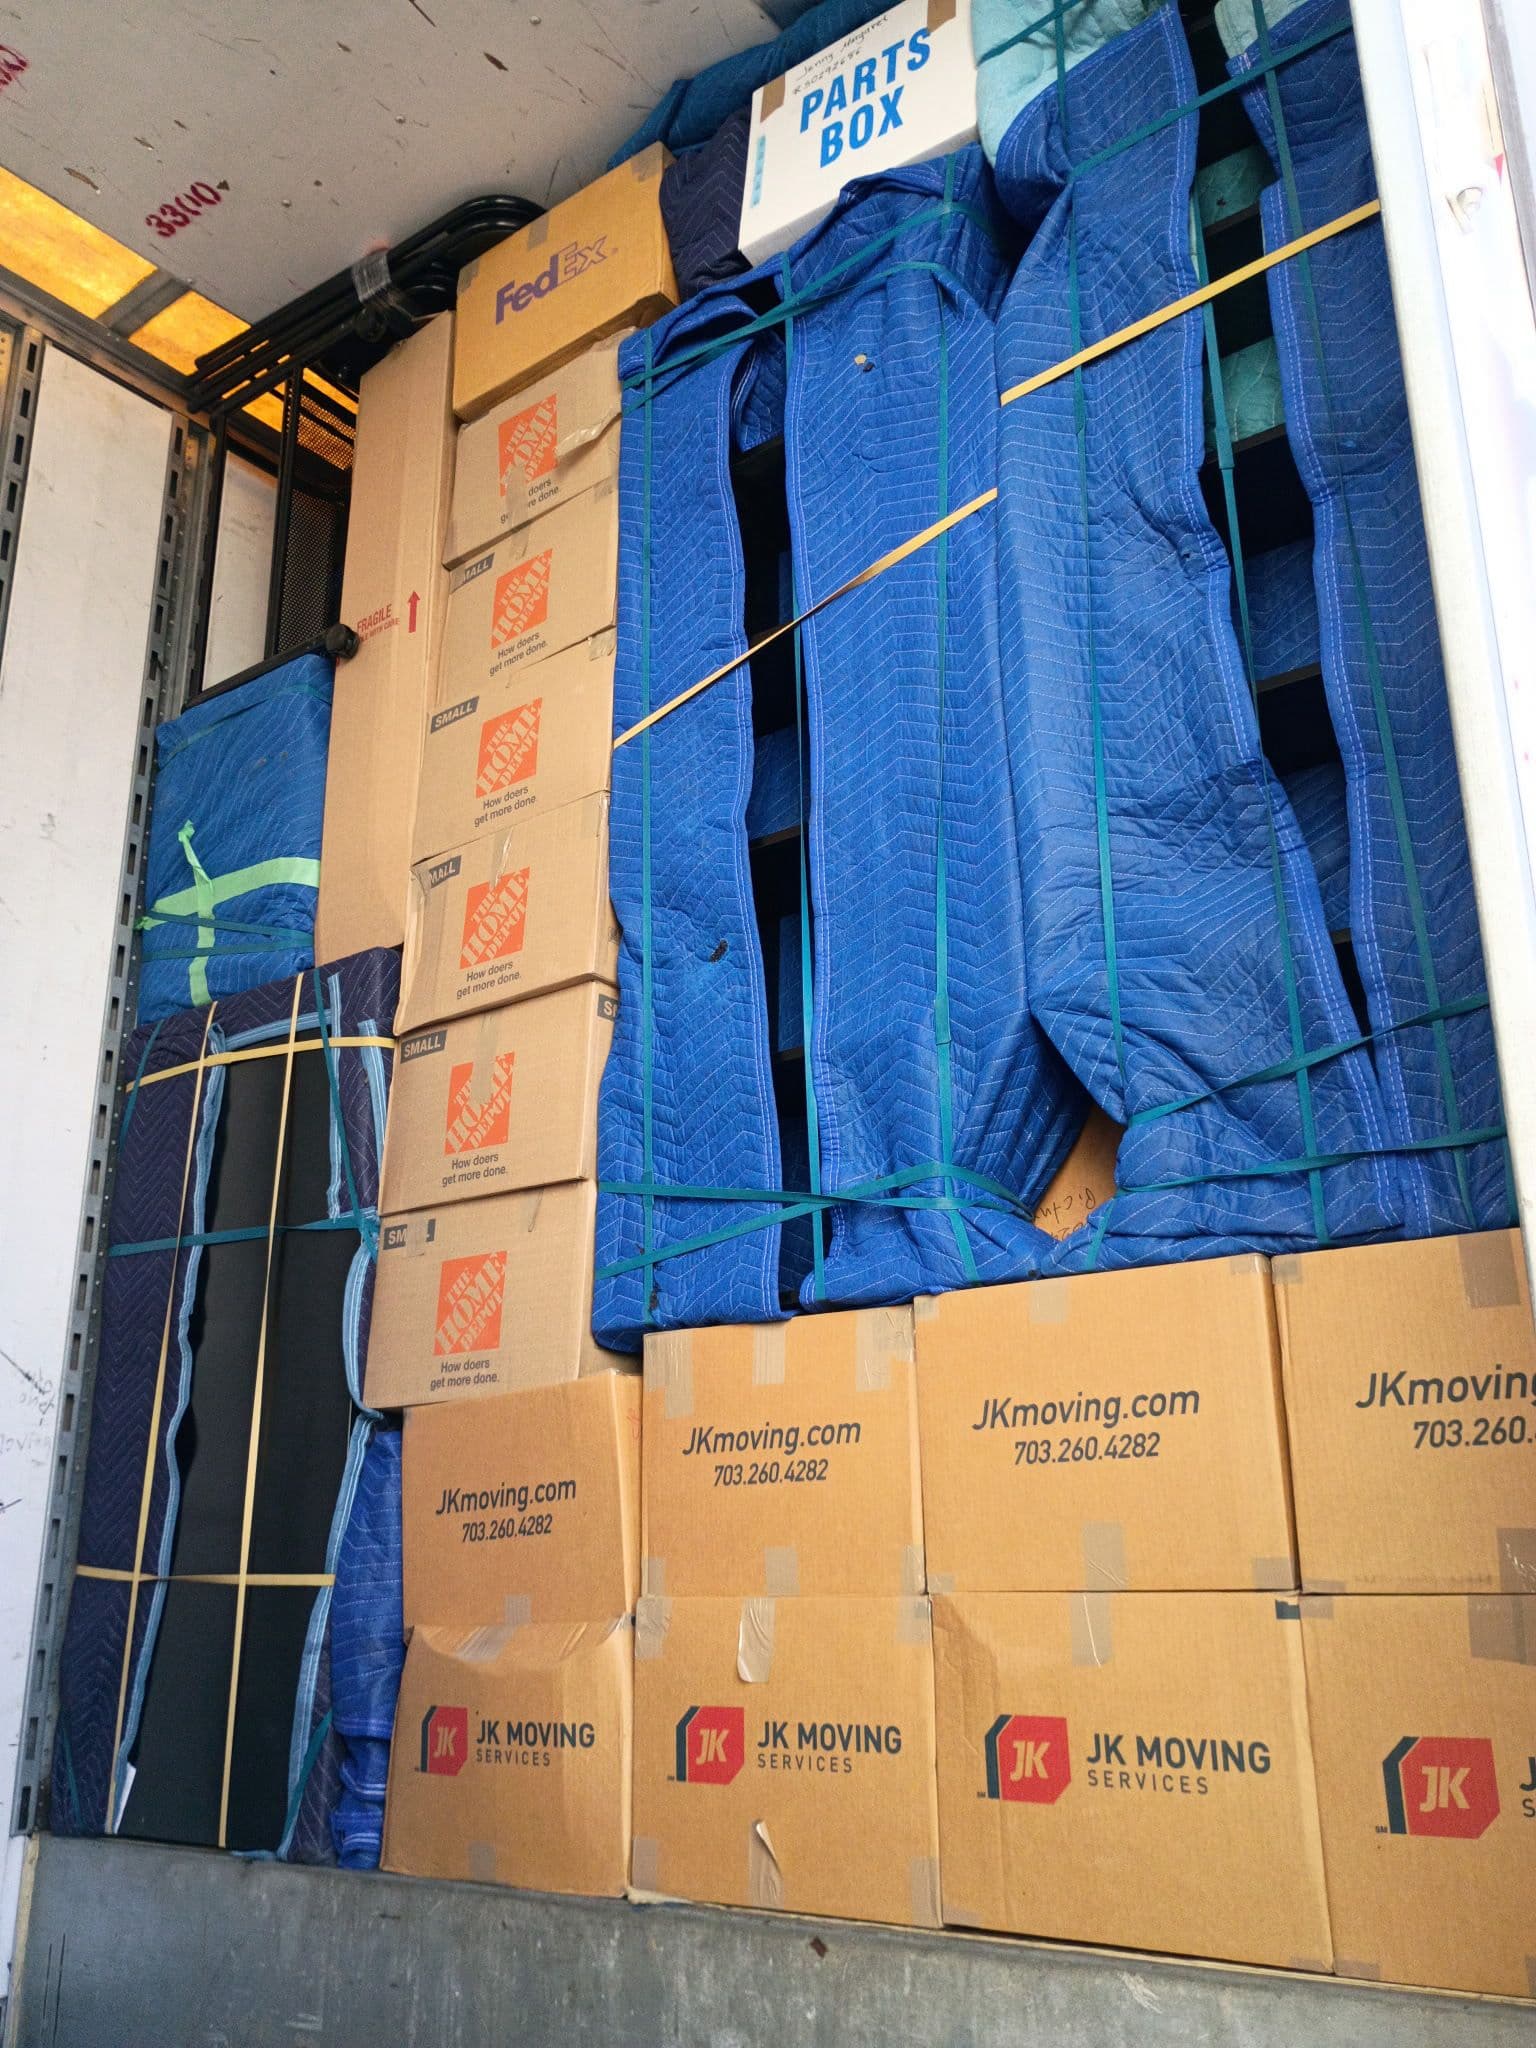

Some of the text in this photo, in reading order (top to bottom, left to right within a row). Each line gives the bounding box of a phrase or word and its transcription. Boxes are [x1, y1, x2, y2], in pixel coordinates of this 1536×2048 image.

[800, 27, 931, 134] PARTS
[820, 85, 904, 168] BOX
[496, 235, 607, 325] FedEx
[504, 419, 529, 456] THE
[528, 479, 552, 497] doers
[492, 552, 551, 645] HOME
[499, 576, 522, 606] THE
[512, 577, 549, 634] DEPOT
[357, 603, 392, 632] FRAGILE
[497, 632, 540, 660] How doers
[489, 662, 502, 677] get
[504, 650, 525, 667] more
[434, 701, 474, 729] SMALL
[476, 697, 541, 792] HOME
[485, 719, 513, 754] THE
[499, 723, 540, 787] DEPOT
[483, 786, 529, 810] How doers
[474, 813, 488, 828] get
[490, 805, 513, 820] more
[429, 861, 456, 884] MALL
[461, 870, 528, 966] HOME
[471, 889, 498, 923] THE
[483, 898, 527, 961] DEPOT
[466, 961, 514, 982] How doers
[456, 986, 471, 1000] get
[472, 980, 495, 993] more
[404, 1036, 441, 1058] SMALL
[469, 1082, 512, 1148] DEPOT
[451, 1151, 499, 1170] How doers
[442, 1174, 457, 1188] get
[458, 1170, 481, 1183] more
[444, 1267, 474, 1305] THE
[435, 1252, 506, 1354] HOME
[460, 1287, 504, 1351] DEPOT
[430, 1370, 500, 1391] get more done.
[440, 1358, 490, 1373] How doers
[1355, 1364, 1536, 1408] JKmovin
[972, 1390, 1200, 1430] JKmoving.com
[682, 1421, 861, 1456] JKmoving.com
[1015, 1432, 1161, 1465] 703.260.4282
[1413, 1415, 1536, 1449] 703.260.
[714, 1458, 829, 1487] 703.260.4282
[435, 1479, 576, 1515] JKmoving.com
[462, 1513, 553, 1542] 703.260.4282
[433, 1726, 457, 1758] JK
[476, 1719, 595, 1748] JK MOVING
[695, 1728, 729, 1765] JK
[757, 1721, 902, 1754] JK MOVING
[476, 1749, 551, 1767] SERVICES
[757, 1753, 853, 1773] SERVICES
[1010, 1740, 1050, 1782] JK
[1087, 1733, 1271, 1774] JK MOVING
[1087, 1769, 1208, 1795] SERVICES
[1419, 1765, 1471, 1812] JK
